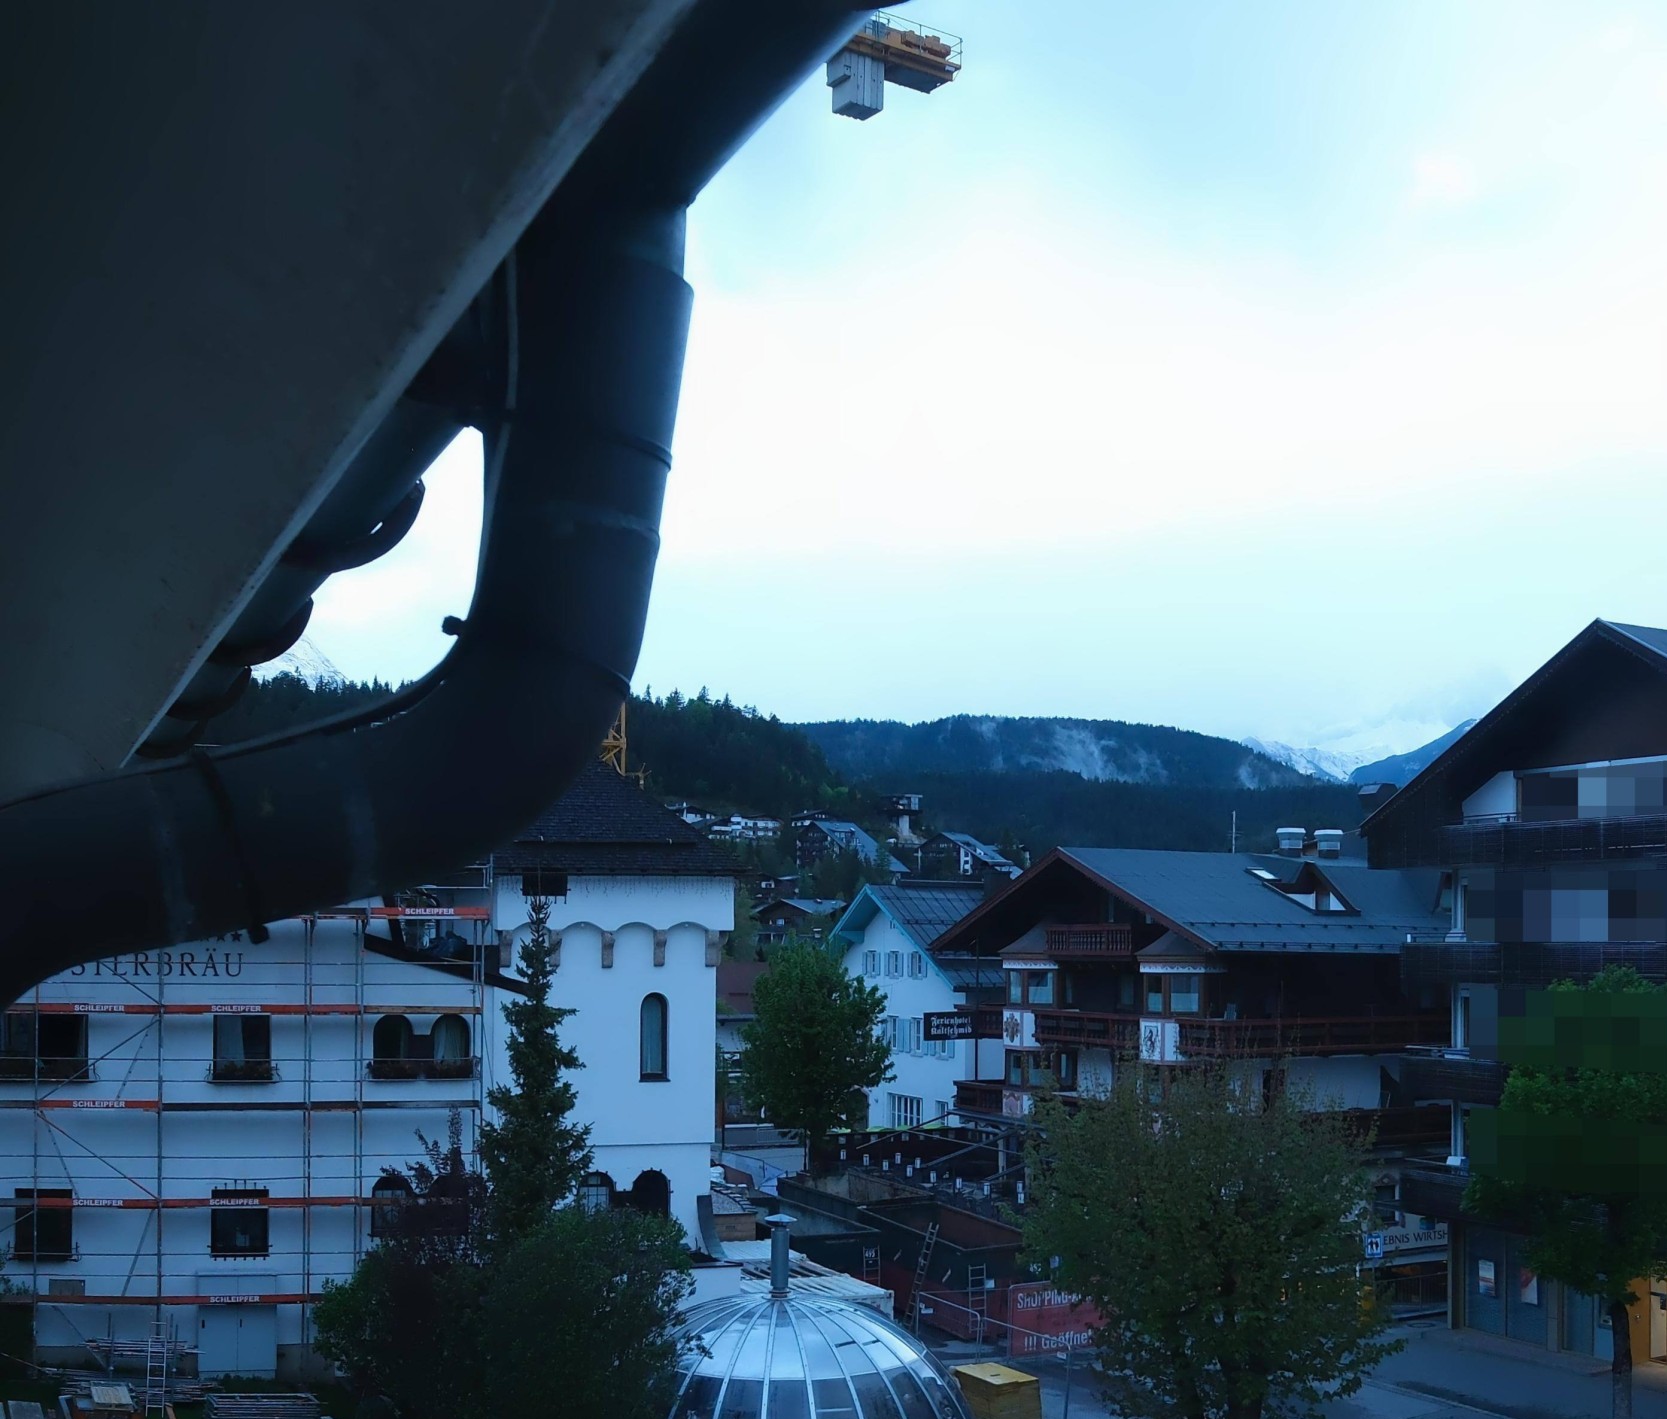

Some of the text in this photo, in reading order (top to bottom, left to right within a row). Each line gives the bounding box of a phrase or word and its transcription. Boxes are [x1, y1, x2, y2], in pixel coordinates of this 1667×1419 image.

[404, 907, 455, 915] SCHLEIPFER
[71, 947, 244, 977] STERBRÄU
[74, 1004, 124, 1012] SCHLEIPFER
[211, 1004, 261, 1012] SCHLEIPFER
[1383, 1230, 1448, 1246] EBNIS WIRTSH
